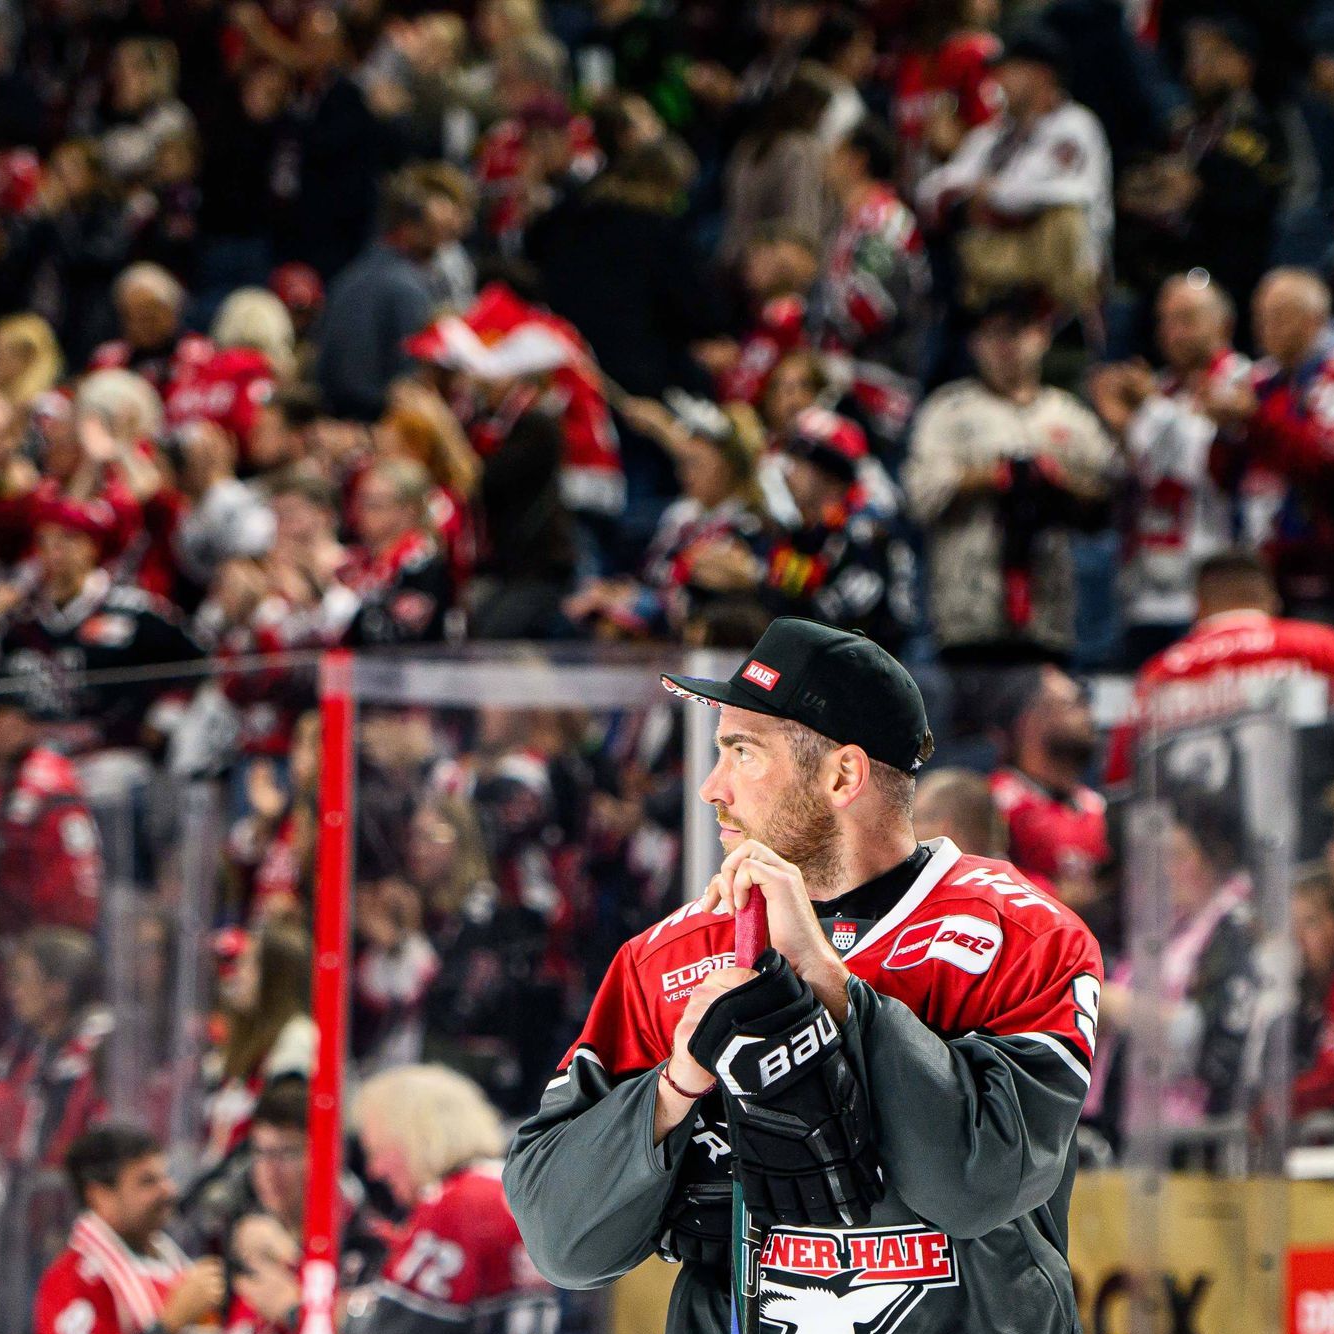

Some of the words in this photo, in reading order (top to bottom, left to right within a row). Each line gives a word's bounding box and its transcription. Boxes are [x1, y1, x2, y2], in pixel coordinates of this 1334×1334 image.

[747, 664, 774, 686] HAIE
[664, 986, 696, 1003] VERS
[758, 1009, 841, 1089] BAU
[848, 1232, 949, 1277] HAIE
